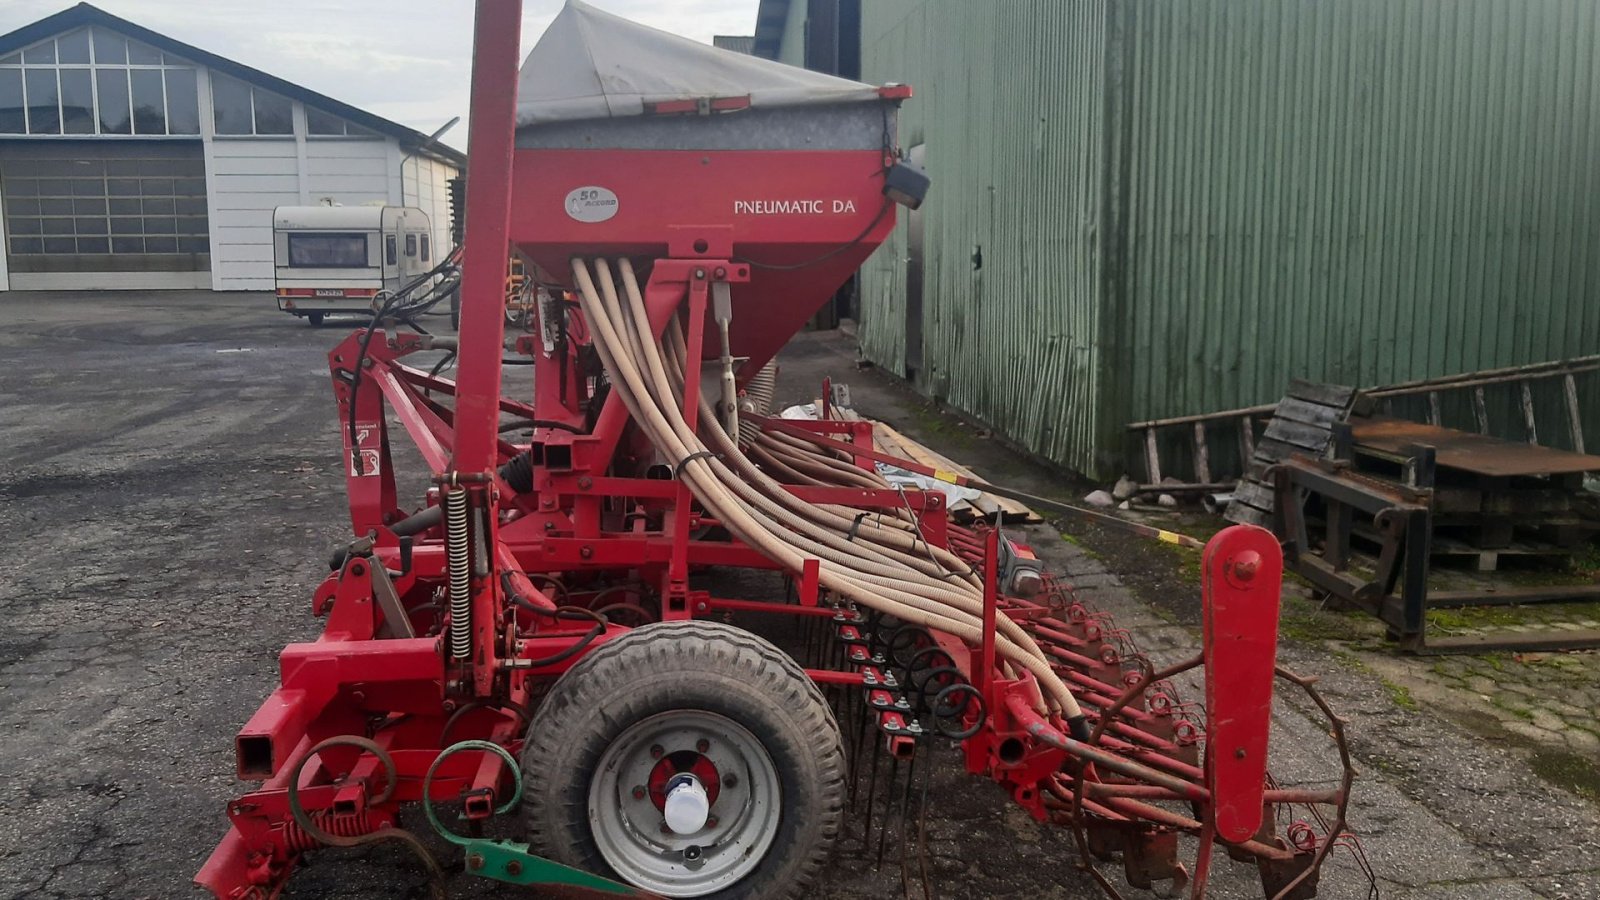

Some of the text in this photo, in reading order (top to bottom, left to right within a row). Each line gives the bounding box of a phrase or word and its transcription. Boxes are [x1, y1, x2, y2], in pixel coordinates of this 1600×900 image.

[580, 190, 599, 201] 50
[734, 199, 856, 214] PNEUMATIC DA
